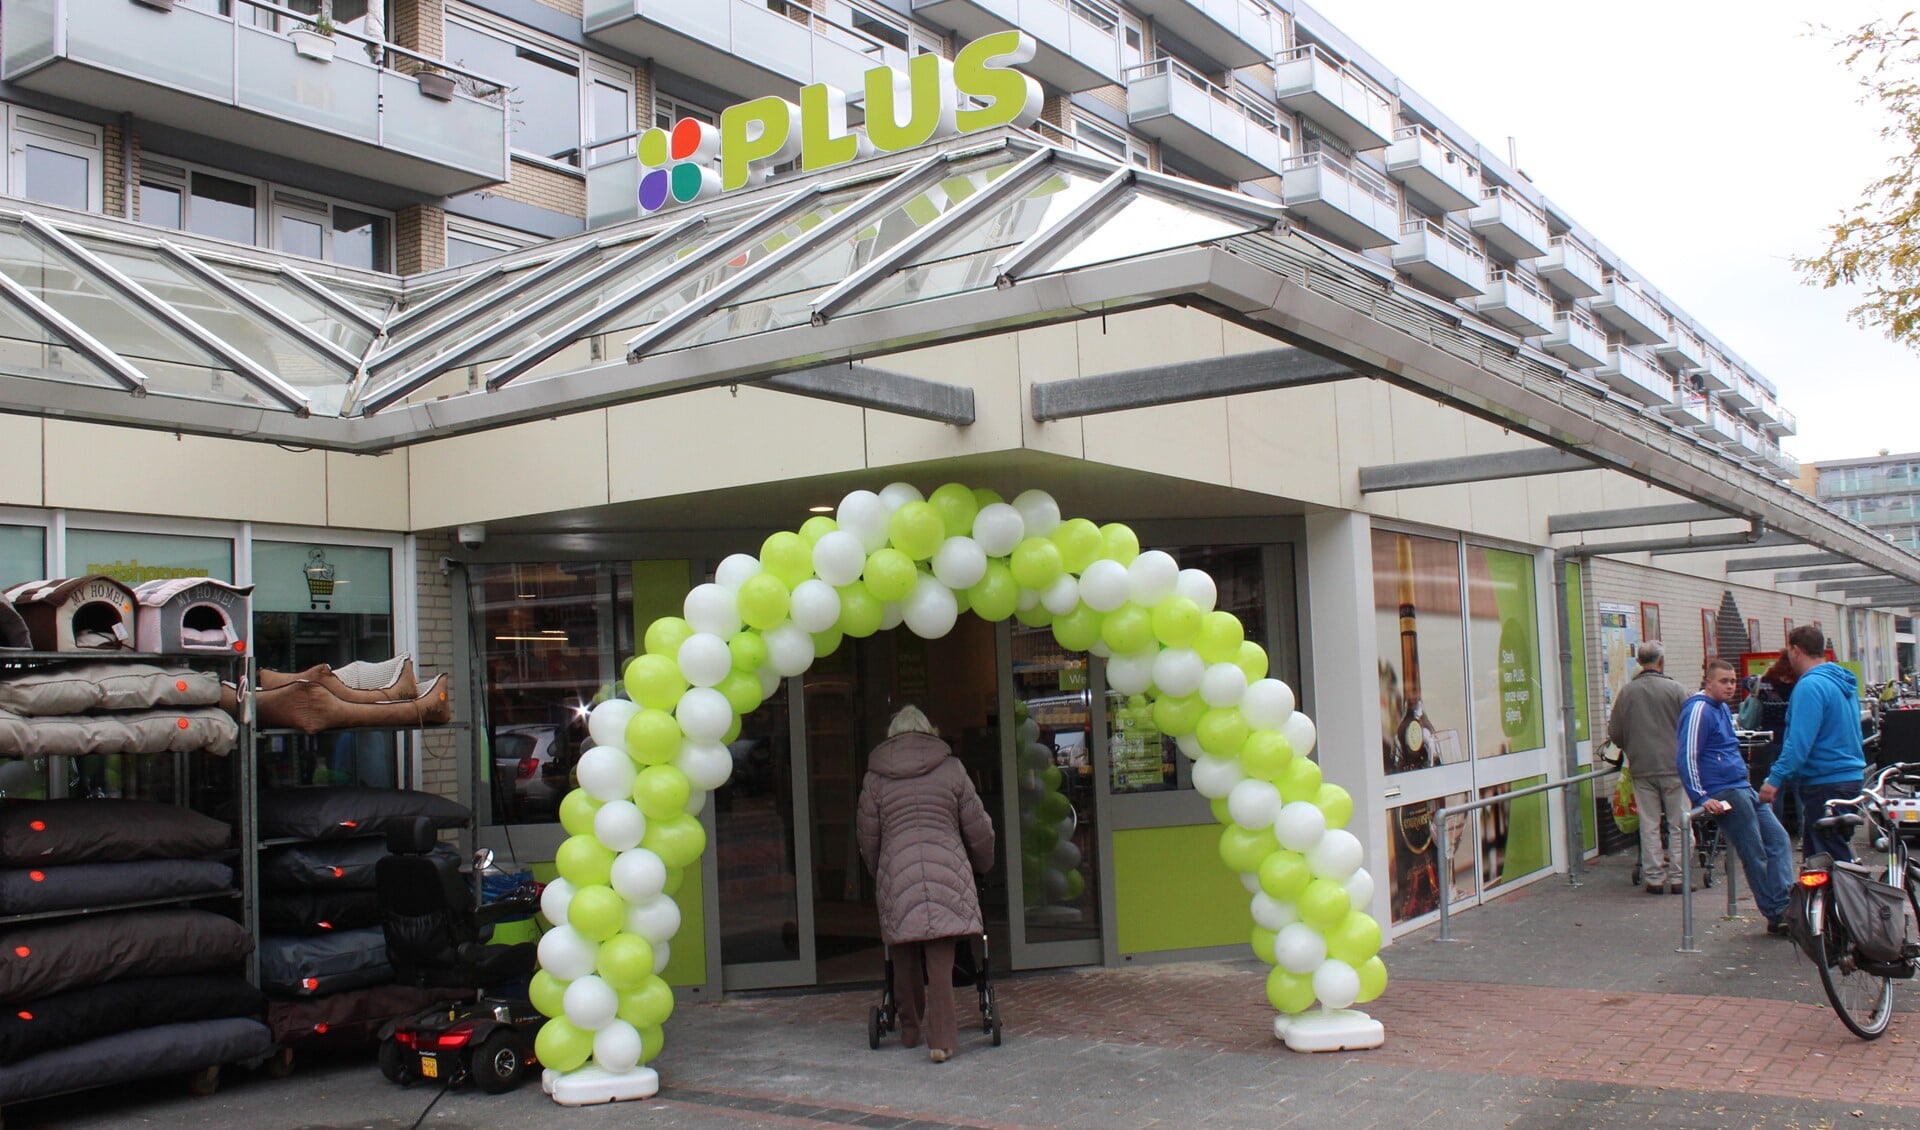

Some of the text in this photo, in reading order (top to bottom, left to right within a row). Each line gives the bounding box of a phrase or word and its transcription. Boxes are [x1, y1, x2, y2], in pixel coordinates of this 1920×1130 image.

[721, 29, 1038, 192] PLUS
[71, 584, 125, 607] MY HOME!
[175, 587, 235, 608] MY HOME!
